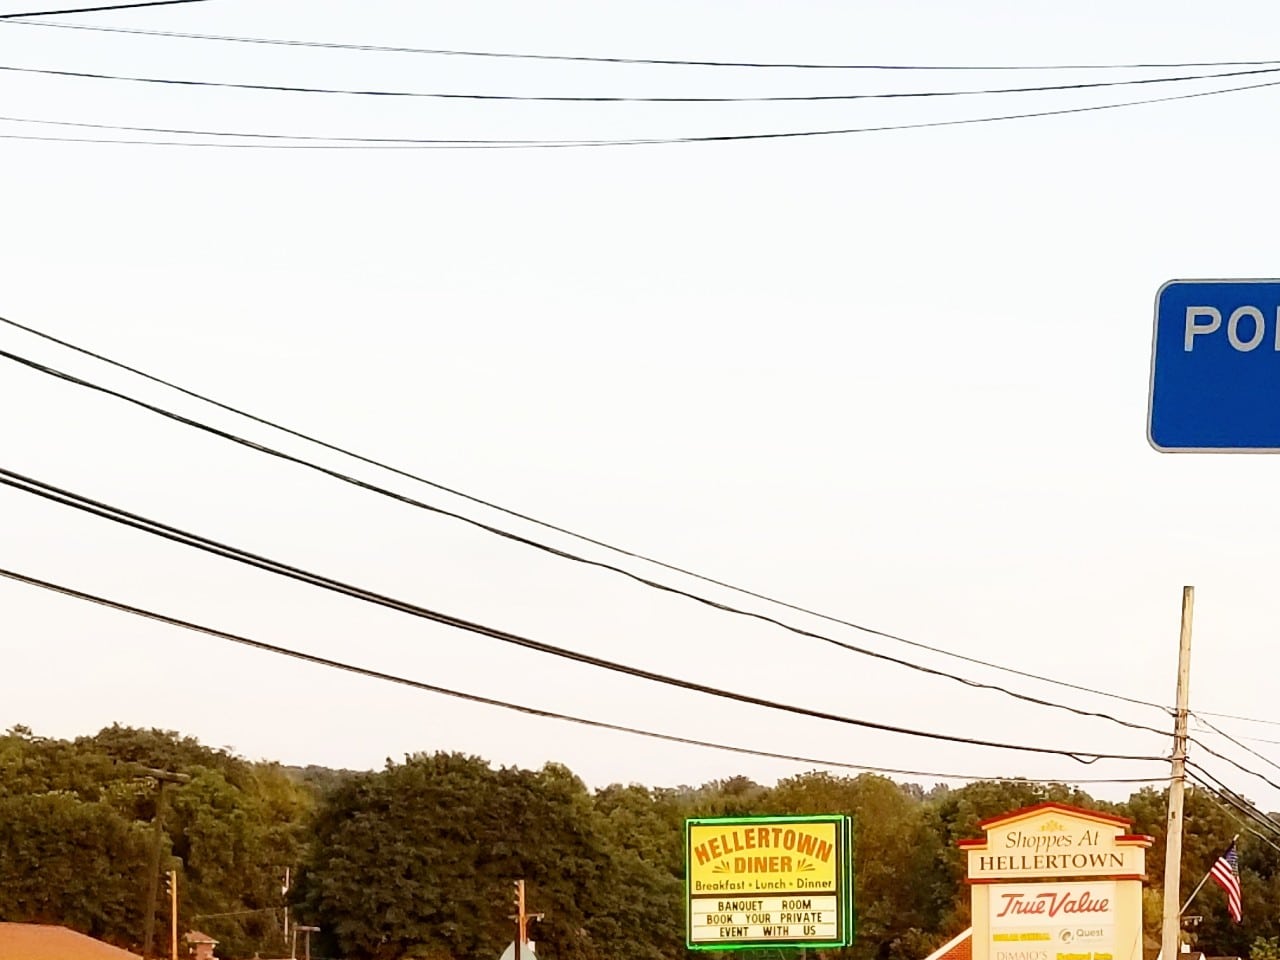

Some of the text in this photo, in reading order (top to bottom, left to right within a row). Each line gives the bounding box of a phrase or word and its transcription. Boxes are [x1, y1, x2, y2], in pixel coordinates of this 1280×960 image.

[694, 827, 833, 866] HELLERTOWN
[1005, 829, 1099, 853] Shoppes At
[734, 856, 793, 874] DINER
[979, 852, 1124, 871] HELLERTOWN
[695, 877, 832, 891] Breakfast Lunch Dinner
[718, 899, 811, 911] BANQUET ROOM
[996, 891, 1109, 918] True Value
[706, 912, 822, 925] BOOK YOUR PRIVATE
[720, 925, 816, 937] EVENT WITH US
[1076, 928, 1104, 937] Quest
